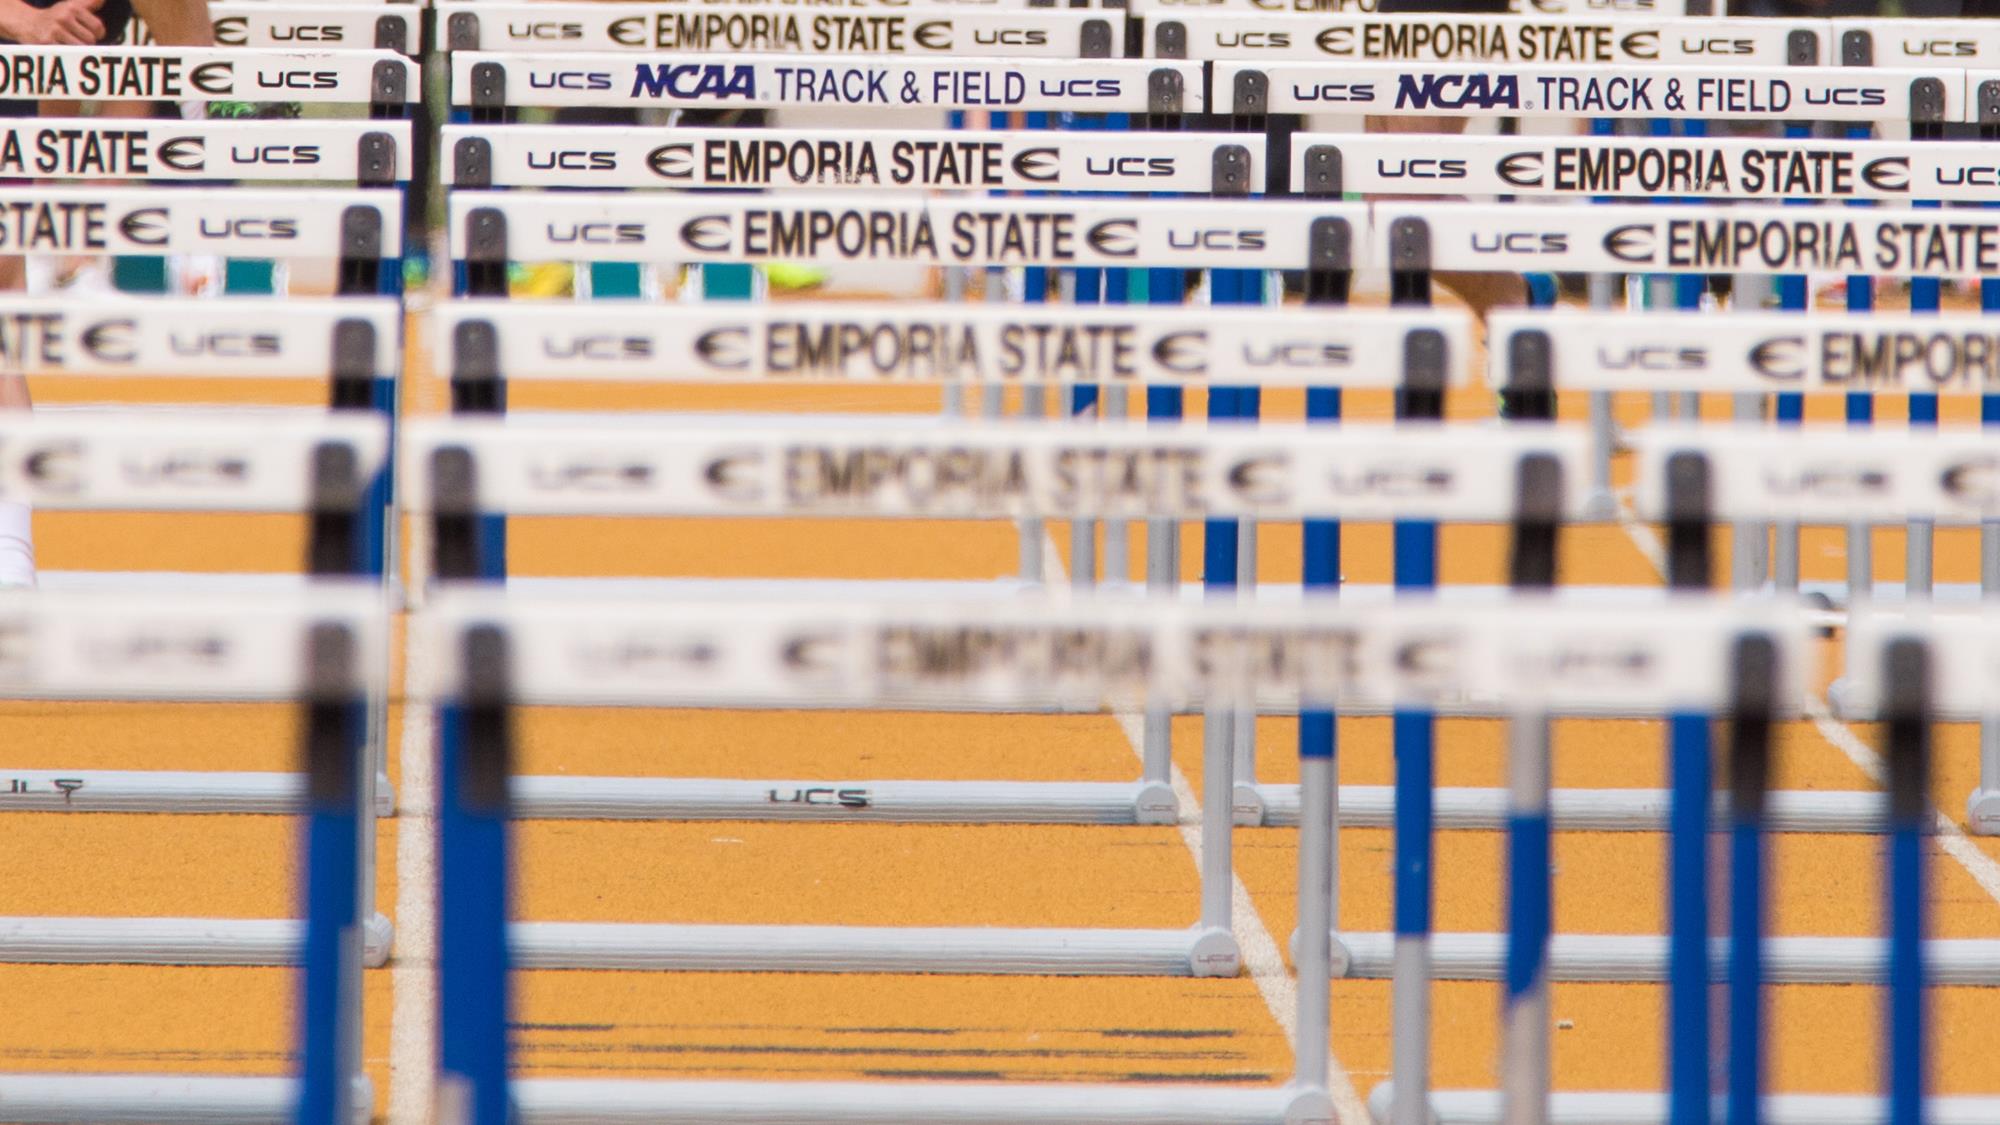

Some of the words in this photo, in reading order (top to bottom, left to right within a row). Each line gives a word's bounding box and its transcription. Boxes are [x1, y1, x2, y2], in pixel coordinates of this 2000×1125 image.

[270, 25, 344, 42] UCS
[508, 23, 584, 40] UCS
[655, 12, 802, 50] EMPORIA
[812, 14, 905, 52] STATE
[974, 29, 1048, 46] UCS
[1215, 32, 1291, 49] UCS
[1363, 22, 1509, 60] EMPORIA
[1518, 24, 1613, 62] STATE
[1681, 38, 1755, 55] UCS
[1902, 40, 1978, 57] UCS
[78, 55, 182, 97] STATE
[257, 71, 339, 89] UCS
[529, 71, 612, 90] UCS
[630, 63, 756, 100] NCAA
[774, 67, 889, 104] TRACK
[900, 70, 921, 104] &
[933, 70, 1026, 105] FIELD
[1039, 79, 1122, 97] UCS
[1293, 84, 1376, 102] UCS
[1394, 73, 1520, 110] NCAA
[1536, 76, 1654, 112] TRACK
[1664, 77, 1686, 112] &
[1697, 78, 1792, 113] FIELD
[1804, 87, 1886, 106] UCS
[35, 128, 149, 174] STATE
[231, 145, 321, 165] UCS
[527, 150, 617, 171] UCS
[704, 139, 880, 185] EMPORIA
[890, 140, 1004, 185] STATE
[1086, 157, 1176, 177] UCS
[1377, 159, 1467, 179] UCS
[1554, 147, 1730, 193] EMPORIA
[1740, 148, 1854, 194] STATE
[1936, 166, 2000, 186] UC
[199, 218, 299, 240] UCS
[547, 223, 646, 244] UCS
[743, 209, 938, 259] EMPORIA
[951, 211, 1075, 261] STATE
[1168, 229, 1267, 251] UCS
[1471, 232, 1569, 254] UCS
[1667, 219, 1862, 269] EMPORIA
[1875, 222, 1999, 273] STATE
[0, 312, 64, 363] TE
[768, 788, 868, 808] UCS
